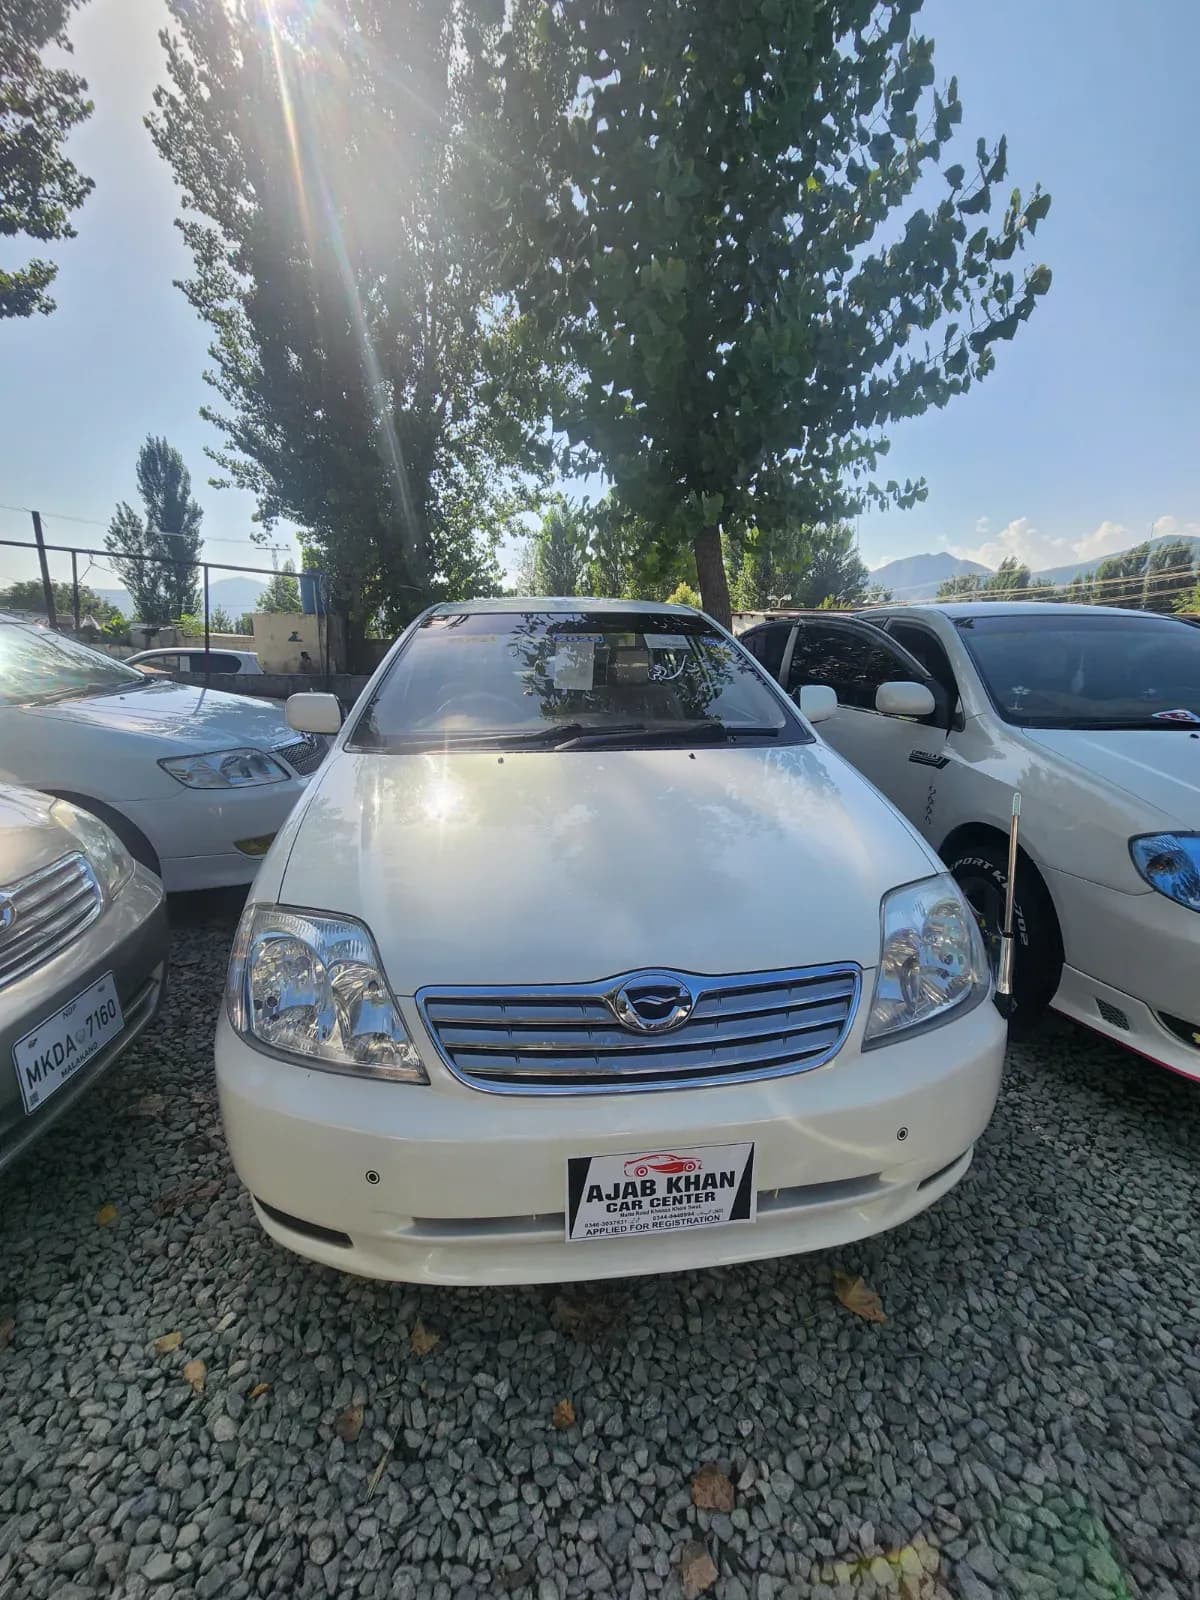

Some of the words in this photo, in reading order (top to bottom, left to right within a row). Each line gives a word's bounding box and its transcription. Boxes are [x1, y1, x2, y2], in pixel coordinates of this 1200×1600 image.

[26, 1034, 77, 1089] MKDA
[86, 998, 117, 1038] 7160
[61, 1041, 99, 1078] MALAKAND
[586, 1179, 656, 1203] AJAB
[667, 1170, 736, 1195] KHAN
[606, 1199, 643, 1213] CAR
[650, 1191, 716, 1208] CENTER
[586, 1225, 627, 1236] APPLIED
[629, 1222, 649, 1232] FOR
[652, 1214, 721, 1229] REGISTRATION
